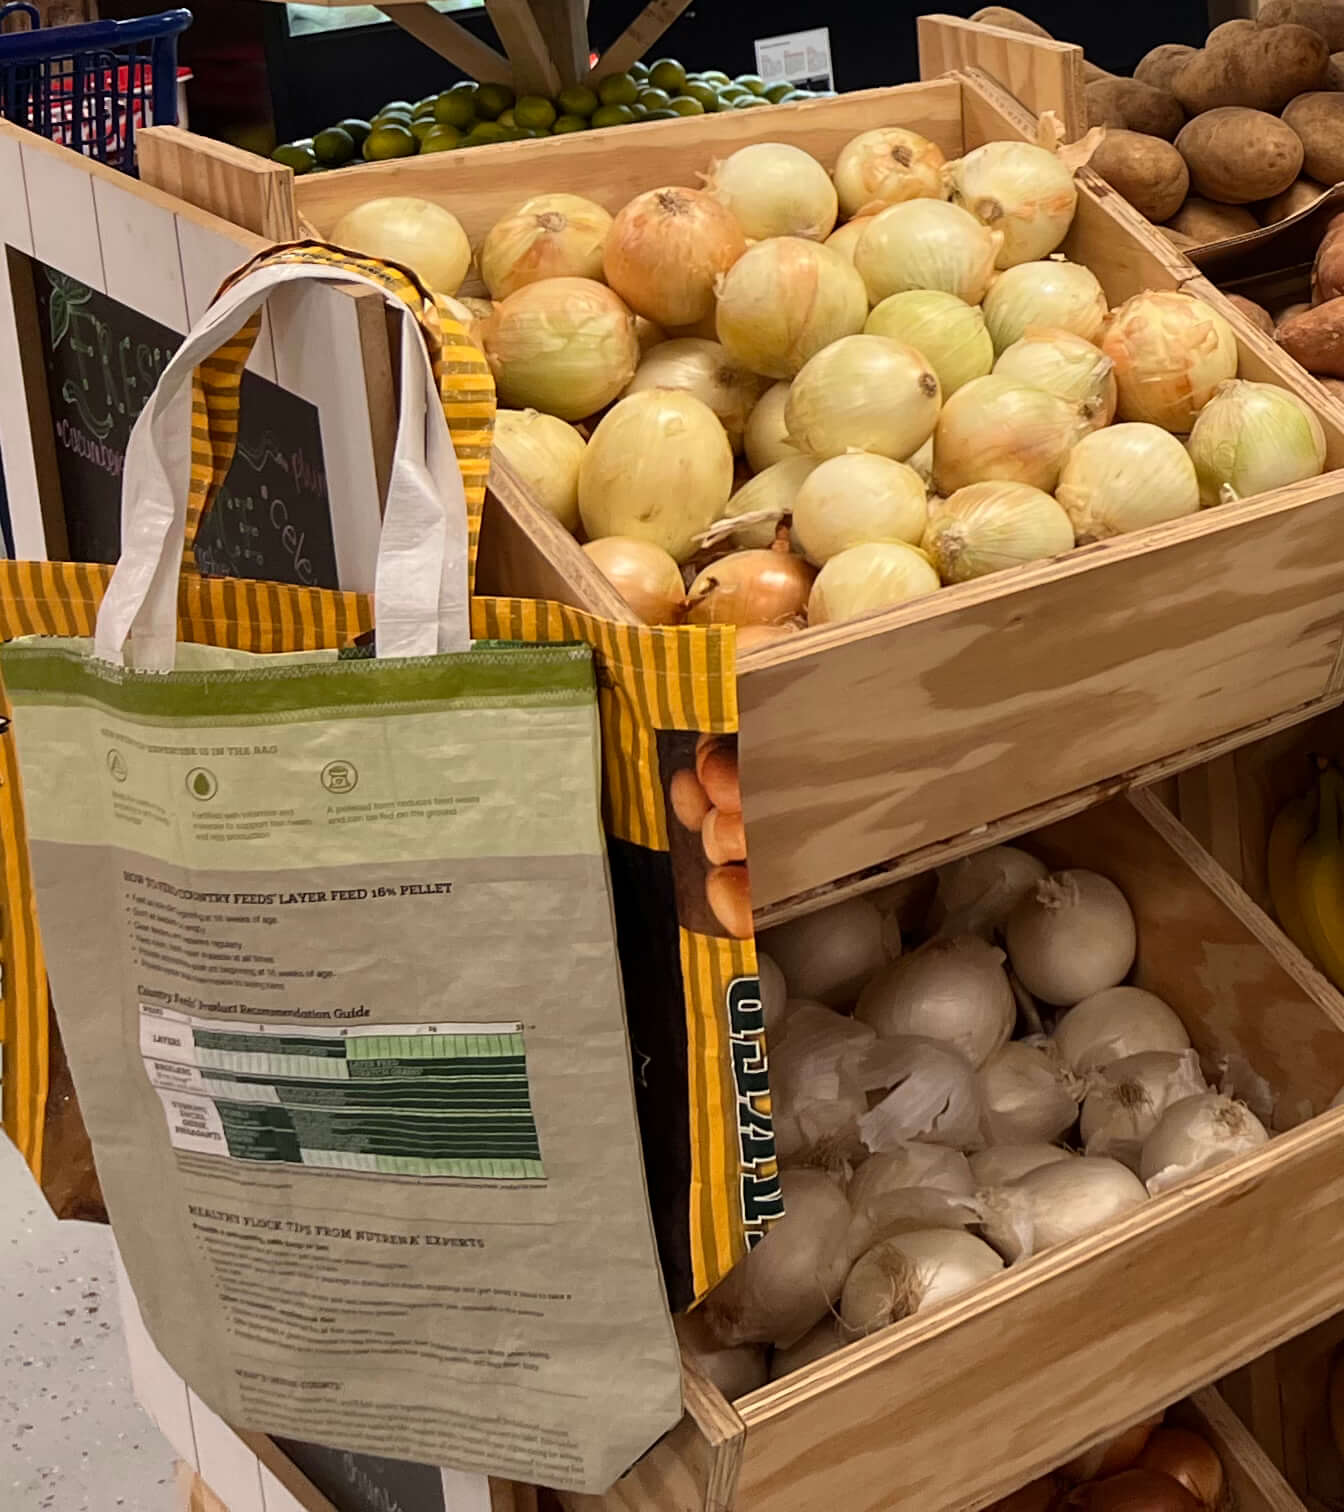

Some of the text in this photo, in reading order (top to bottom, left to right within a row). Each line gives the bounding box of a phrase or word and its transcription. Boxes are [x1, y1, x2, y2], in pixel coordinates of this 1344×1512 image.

[279, 891, 328, 905] LAYER
[331, 888, 368, 903] FEED
[400, 882, 453, 897] PELLET
[240, 1002, 331, 1020] Recommendation
[333, 1004, 371, 1019] Guide
[244, 1216, 282, 1231] FLOCK
[286, 1221, 312, 1236] TIPS
[314, 1225, 352, 1240] FROM
[425, 1234, 485, 1249] EXPERTS
